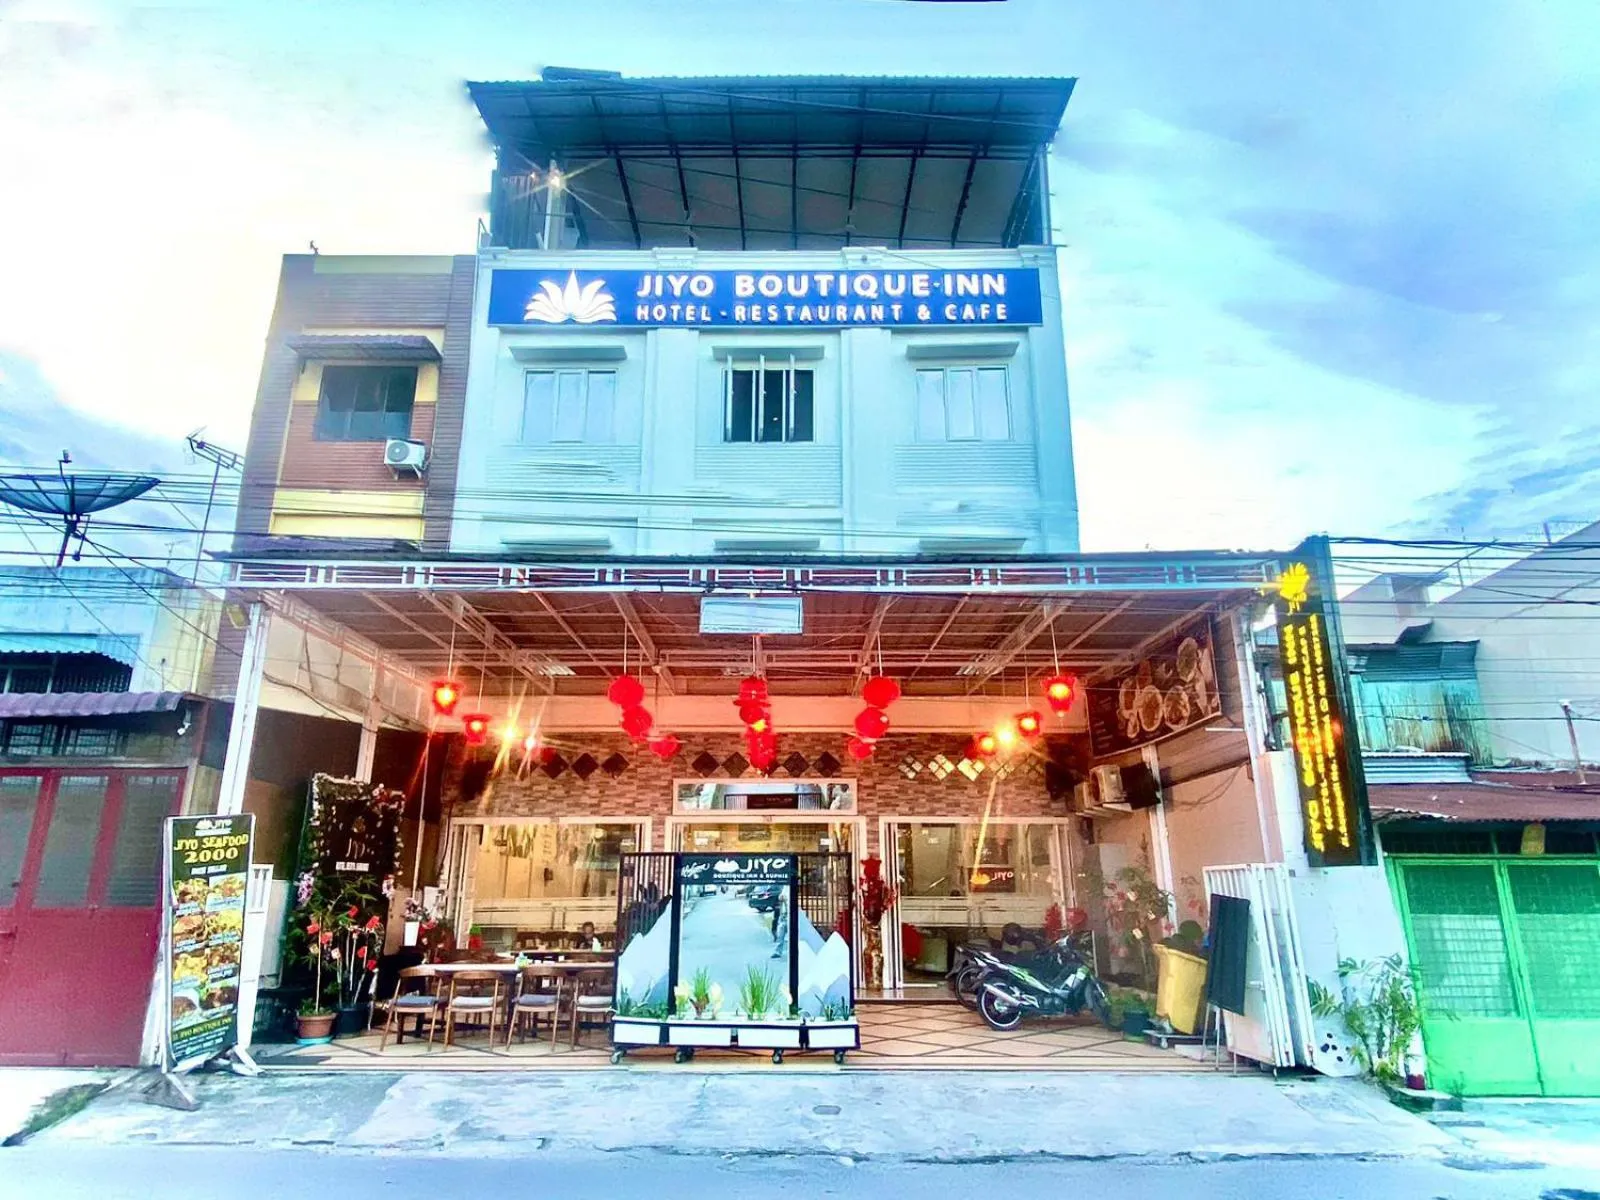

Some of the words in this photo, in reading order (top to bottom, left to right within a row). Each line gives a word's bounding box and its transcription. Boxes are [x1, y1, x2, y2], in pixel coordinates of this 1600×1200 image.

[636, 274, 714, 297] JIYO
[636, 304, 712, 322] HOTEL
[735, 304, 902, 322] RESTAURANT
[917, 303, 931, 320] &
[944, 303, 1008, 321] CAFE
[174, 839, 198, 851] JIYO
[202, 833, 249, 848] SEAFOOD
[184, 847, 238, 863] 2000
[740, 858, 788, 873] JIYO
[992, 871, 1013, 880] JIYO
